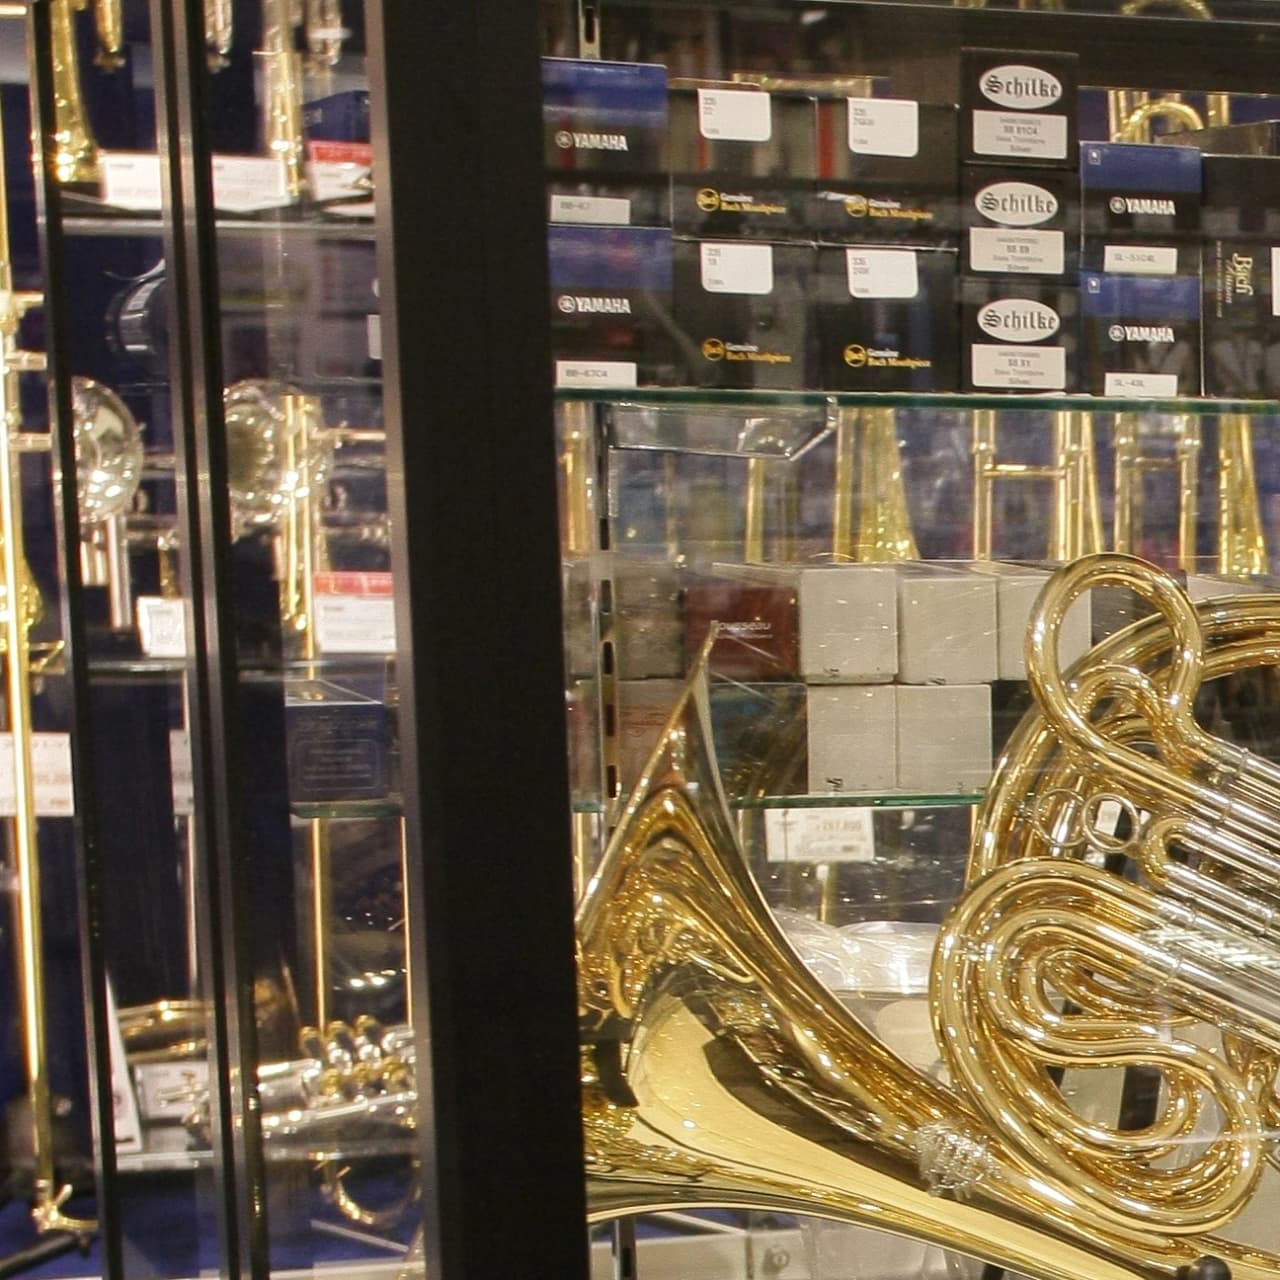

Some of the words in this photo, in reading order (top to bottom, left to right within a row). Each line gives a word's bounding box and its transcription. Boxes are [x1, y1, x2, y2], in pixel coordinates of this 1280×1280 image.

[985, 74, 1059, 100] Schilke
[573, 133, 629, 151] YAMAHA
[982, 192, 1054, 214] Schilke
[1126, 198, 1176, 216] YAMAHA
[1232, 253, 1254, 296] Bach
[575, 296, 631, 314] YAMAHA
[984, 309, 1056, 332] Schilke
[1125, 326, 1175, 342] YAMAHA
